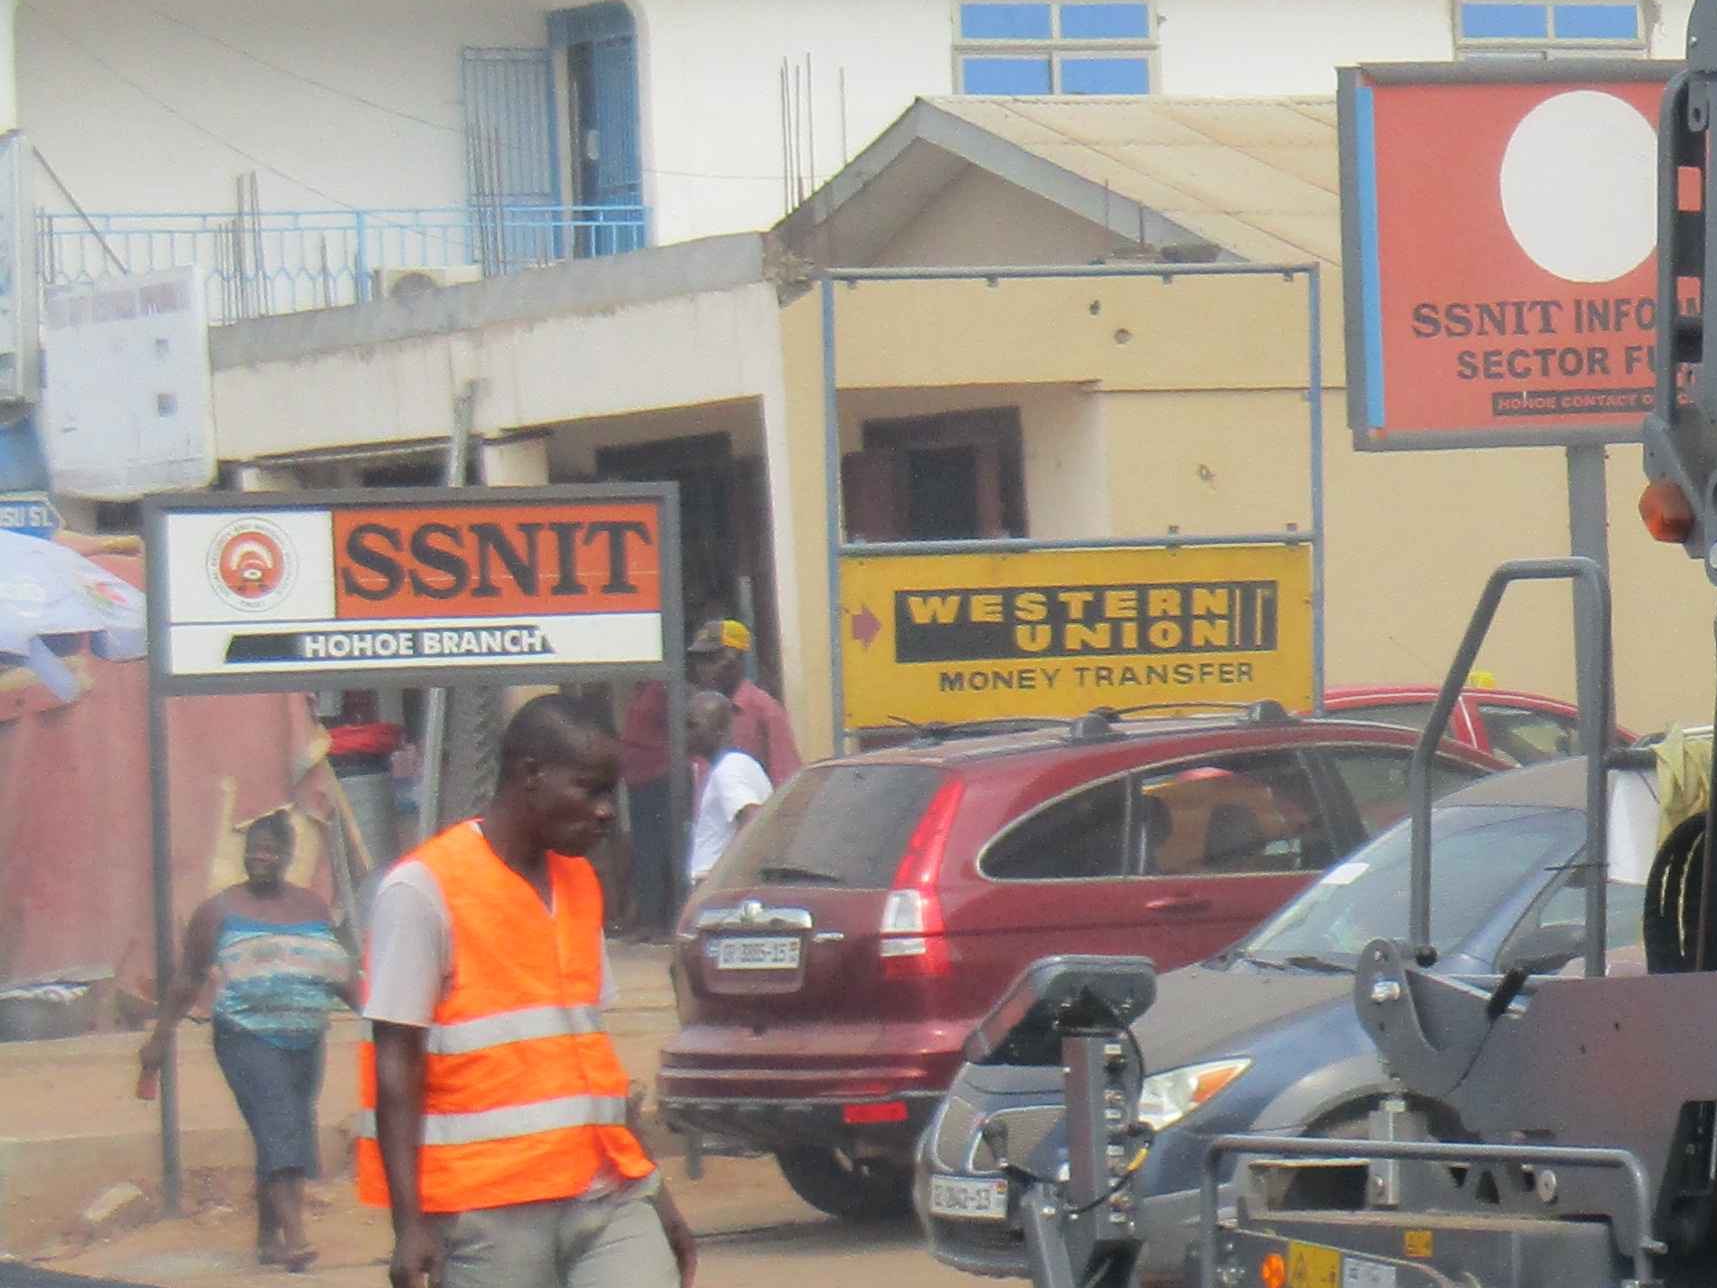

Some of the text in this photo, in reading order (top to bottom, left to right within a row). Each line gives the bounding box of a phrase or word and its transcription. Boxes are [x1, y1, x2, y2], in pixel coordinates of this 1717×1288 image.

[1411, 299, 1563, 338] SSNIT
[1456, 346, 1610, 380] SECTOR
[1561, 393, 1637, 408] CONTACT
[344, 521, 654, 601] SSNIT
[907, 588, 1230, 625] WESTERN
[304, 626, 543, 659] HOHOE BRANCH
[1014, 619, 1229, 652] UNION
[939, 662, 1254, 692] MONEY TRANSFER
